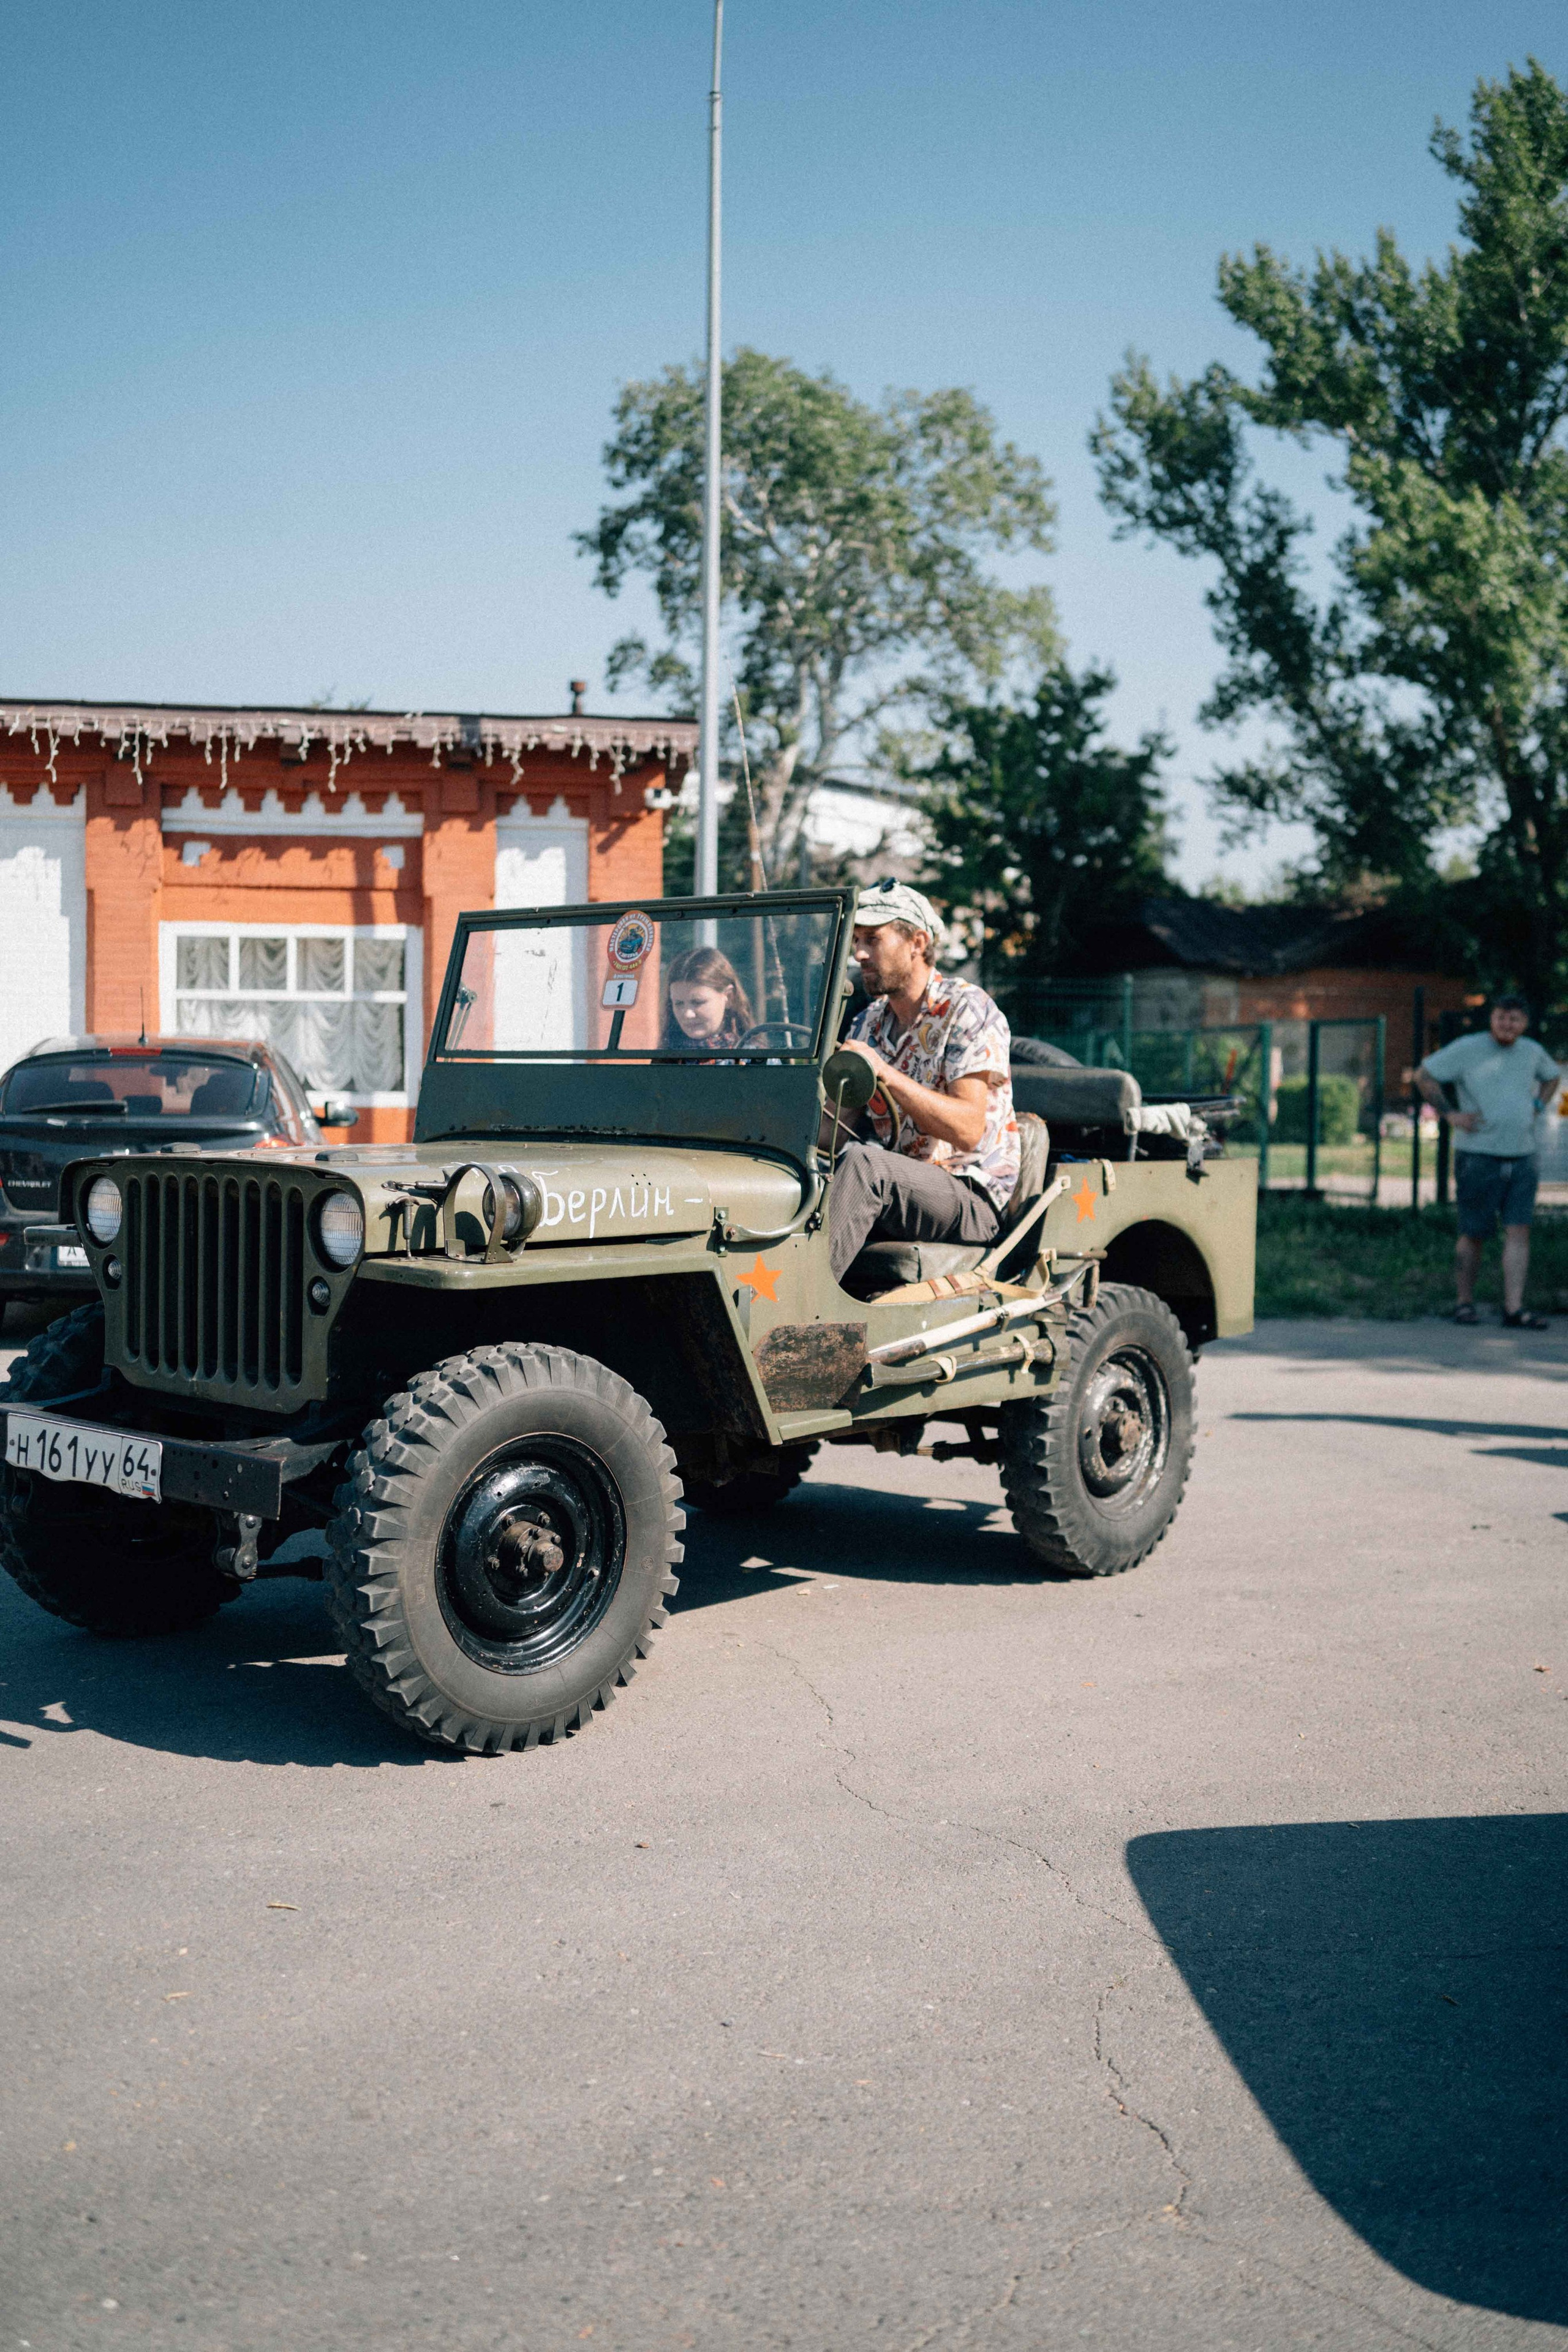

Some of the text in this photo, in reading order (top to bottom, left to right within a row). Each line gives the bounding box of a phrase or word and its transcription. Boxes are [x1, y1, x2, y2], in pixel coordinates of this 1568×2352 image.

[617, 982, 624, 1002] 1
[123, 1444, 149, 1481] 64
[121, 1478, 141, 1492] RUS
